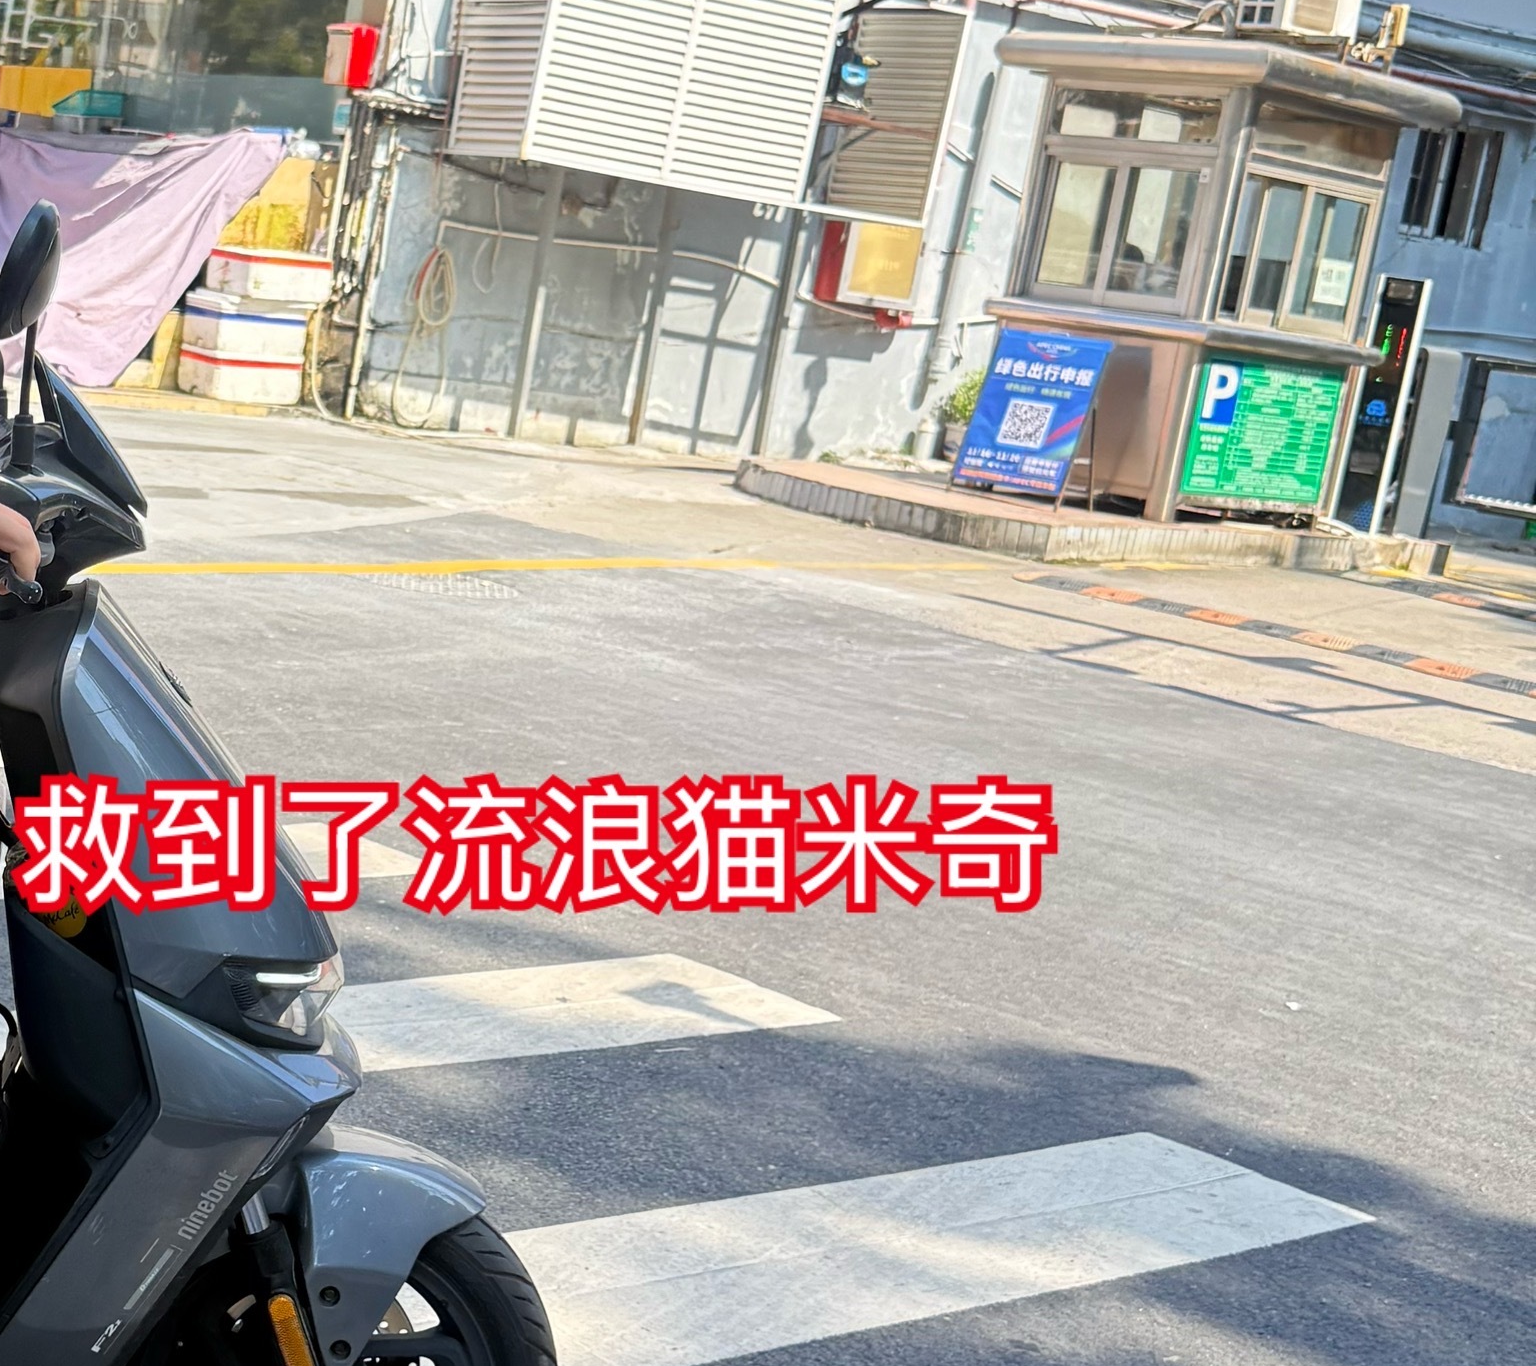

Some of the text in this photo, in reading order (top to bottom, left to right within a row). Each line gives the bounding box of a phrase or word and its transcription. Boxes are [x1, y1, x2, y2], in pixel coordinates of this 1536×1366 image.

[994, 357, 1095, 387] 绿色出行申报
[1201, 363, 1239, 419] P
[177, 1170, 239, 1241] ninebot
